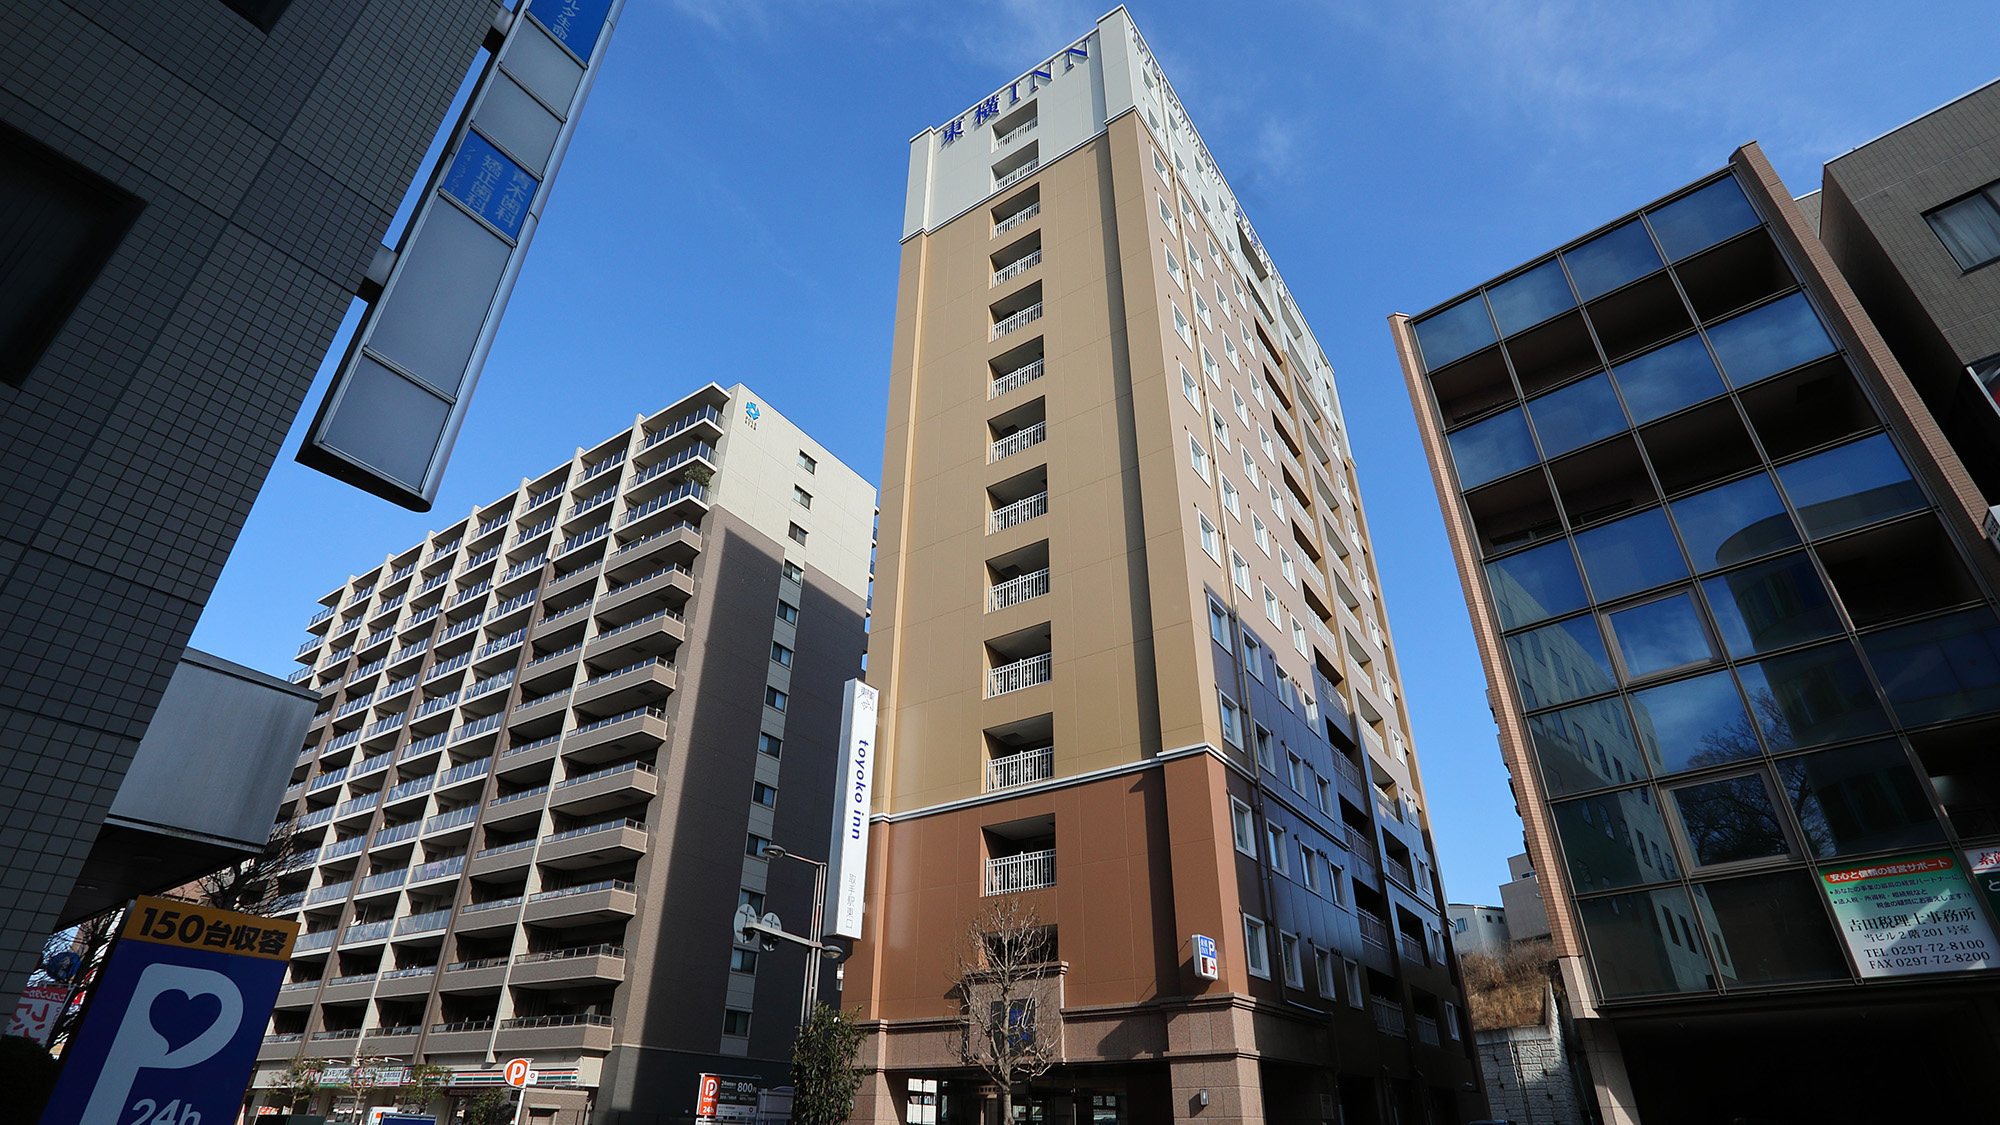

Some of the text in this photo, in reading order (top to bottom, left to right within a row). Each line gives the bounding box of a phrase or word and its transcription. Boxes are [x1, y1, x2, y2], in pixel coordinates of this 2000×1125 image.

[851, 739, 869, 840] toyoko inn
[1829, 859, 1949, 881] 安心と信頼の経営サポート
[139, 907, 289, 956] 150台収容
[1848, 907, 1977, 932] 吉田税理士事務所
[1864, 939, 1985, 959] TEL 0297-72-8100
[1869, 950, 1991, 970] FAX 0297-72-8200
[131, 1098, 202, 1125] 24h
